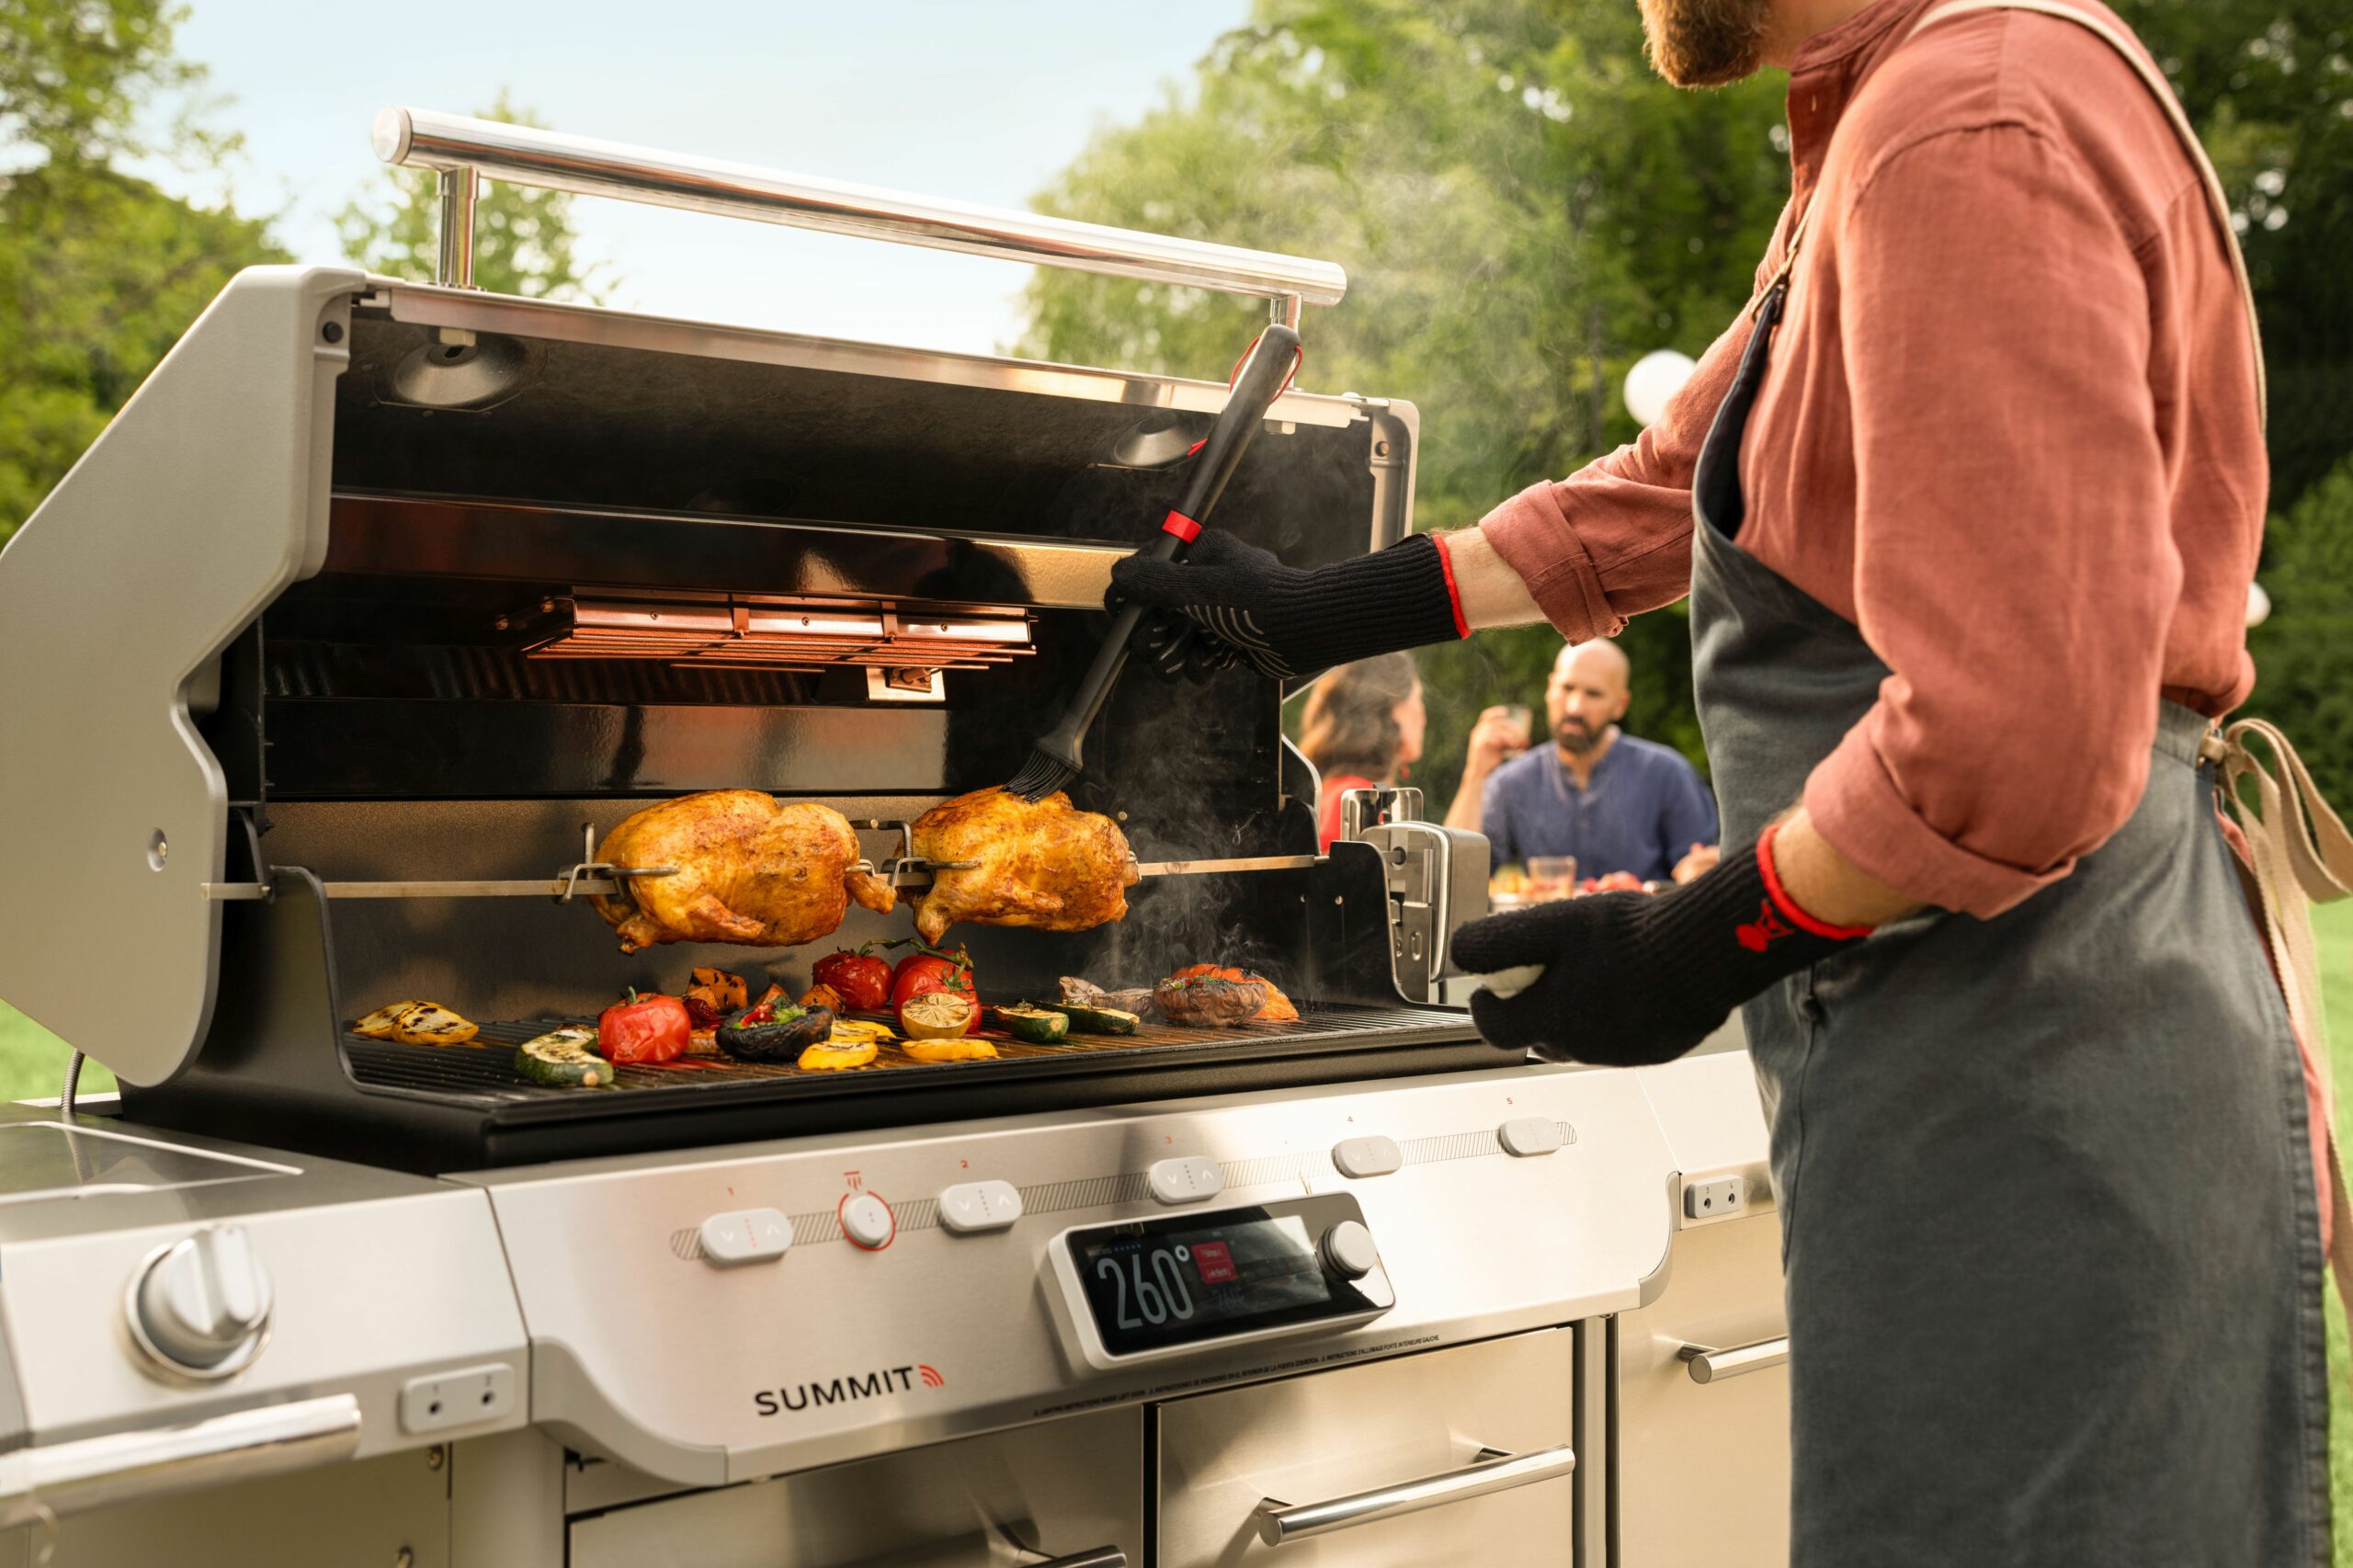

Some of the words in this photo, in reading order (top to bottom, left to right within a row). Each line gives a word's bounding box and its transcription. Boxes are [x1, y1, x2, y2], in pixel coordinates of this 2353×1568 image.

[1506, 1096, 1514, 1106] 5
[1347, 1115, 1355, 1123] 4
[1164, 1135, 1174, 1145] 3
[960, 1159, 970, 1169] 2
[755, 1366, 914, 1416] SUMMIT
